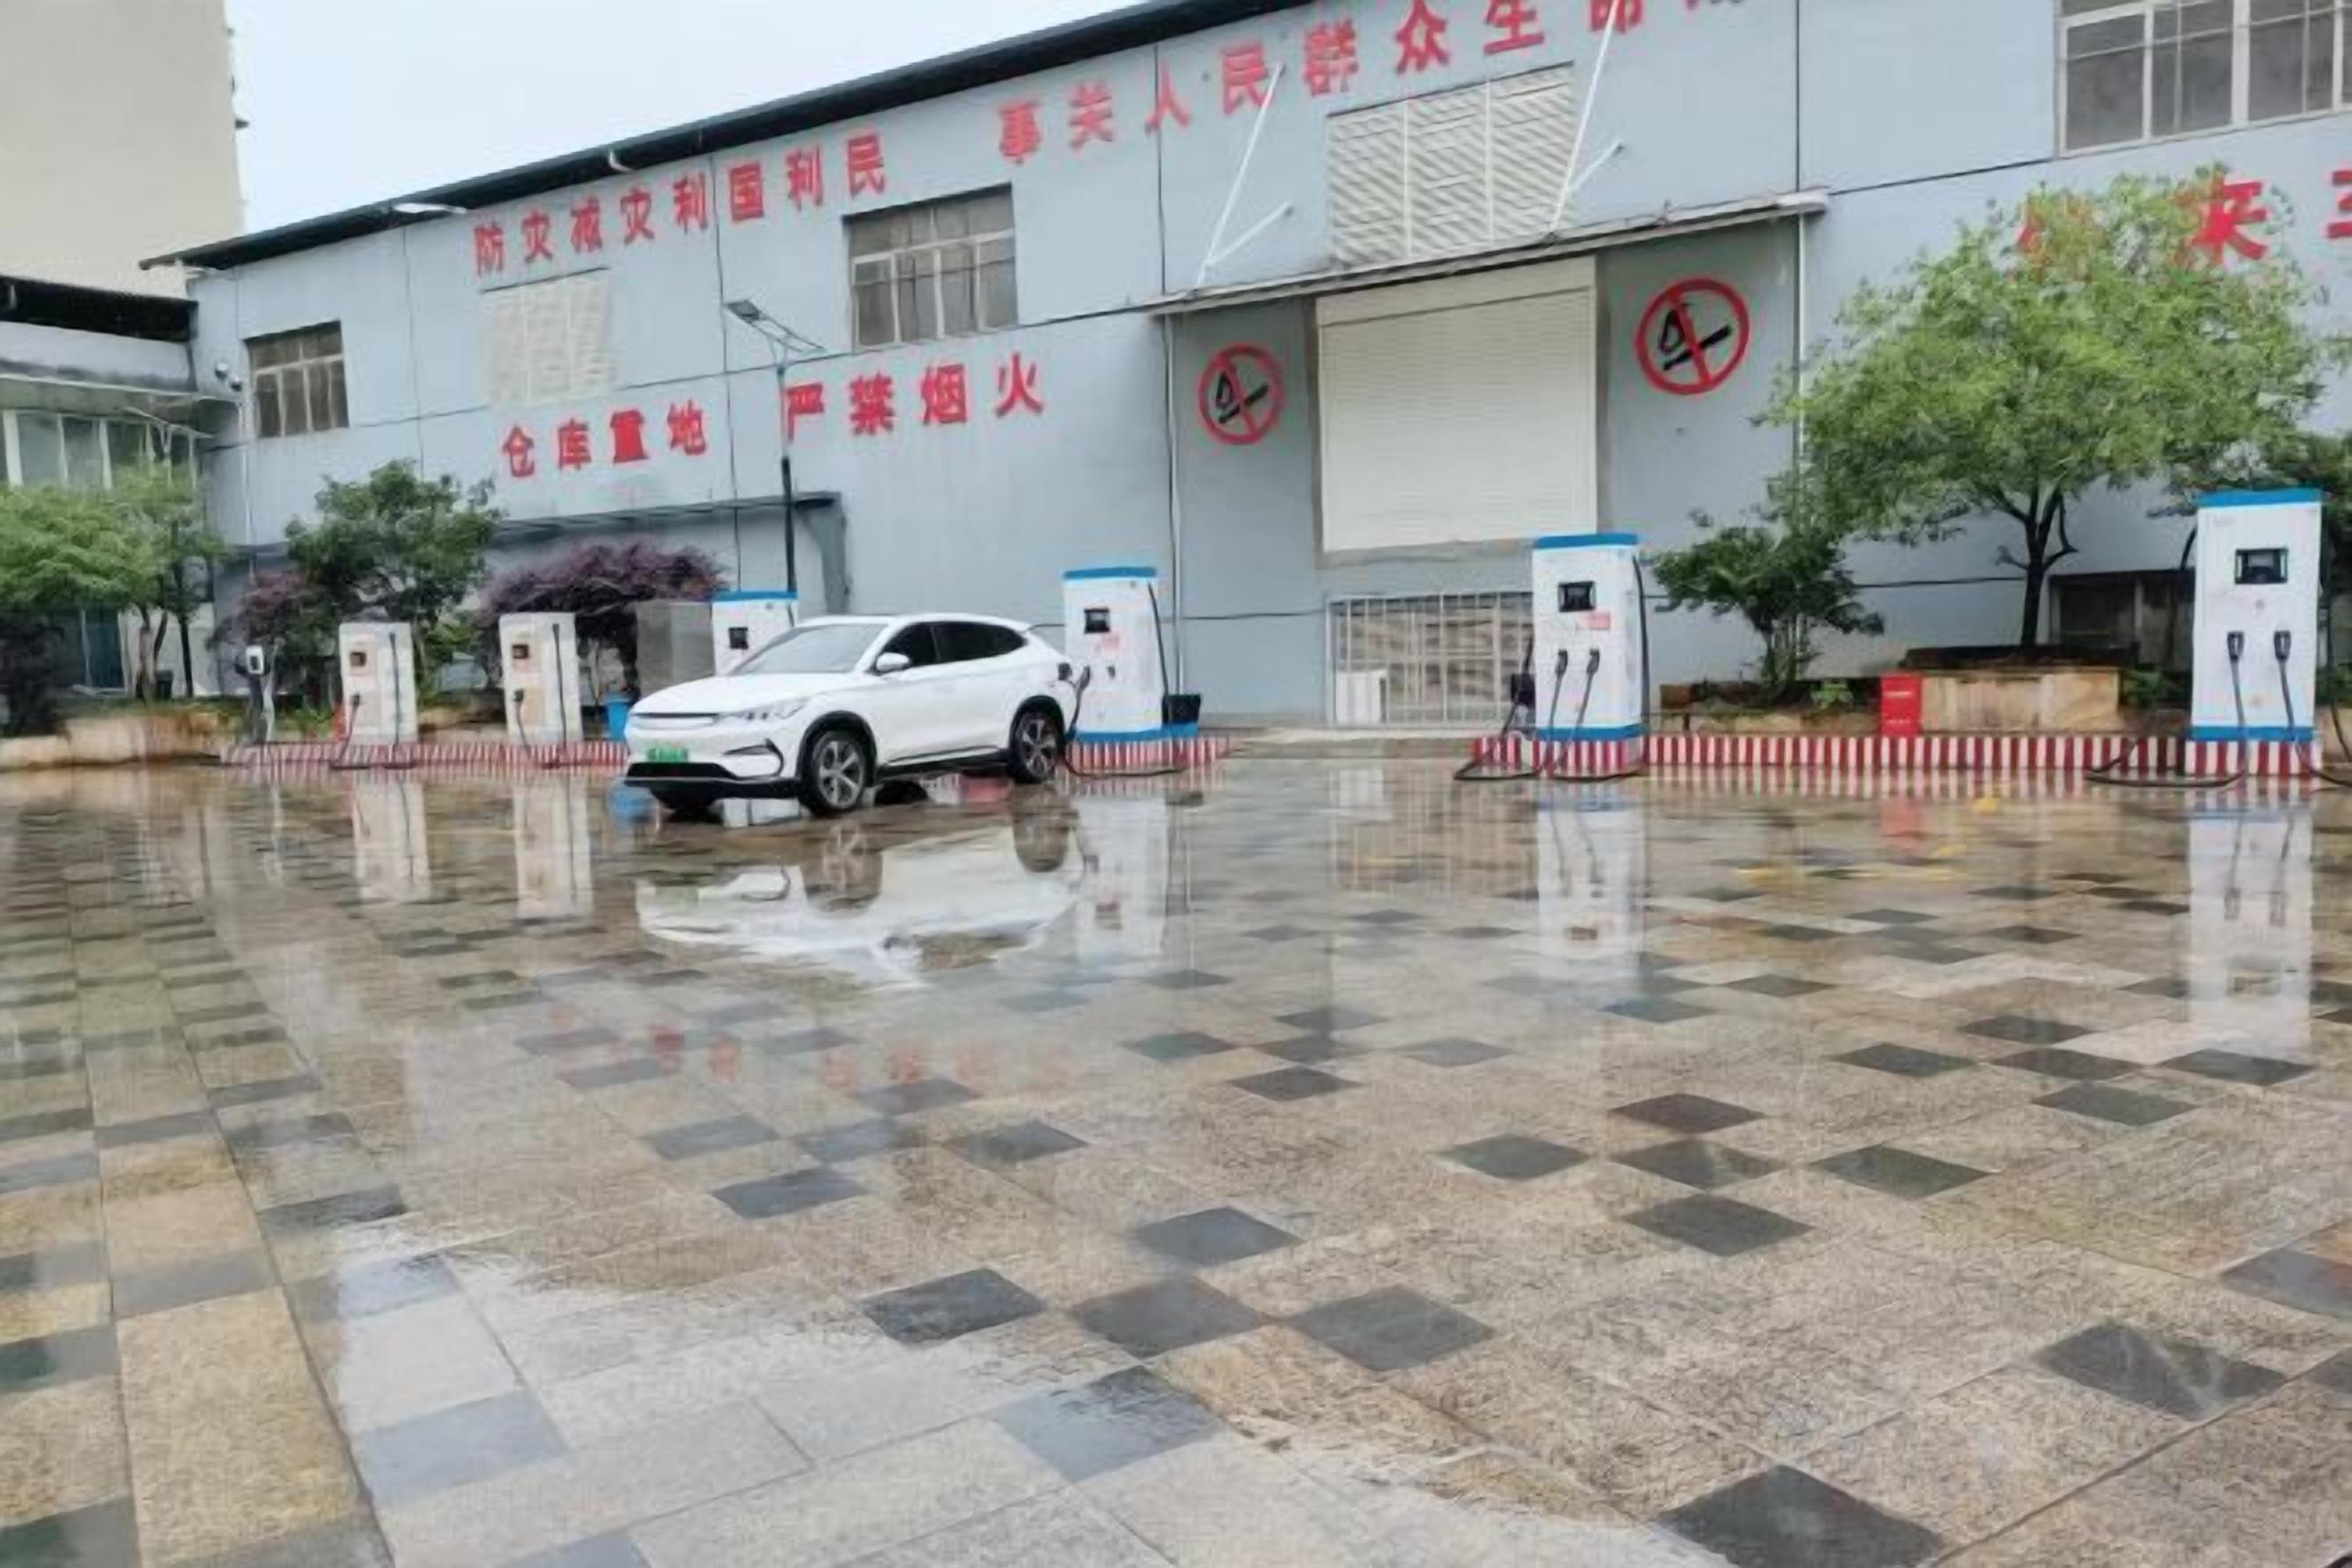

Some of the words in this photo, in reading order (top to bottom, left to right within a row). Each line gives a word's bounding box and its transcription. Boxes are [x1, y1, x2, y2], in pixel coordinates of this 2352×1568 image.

[998, 0, 1740, 164] 事关人民群众生
[502, 399, 707, 478] 仓库重地
[784, 352, 1044, 443] 严禁烟火
